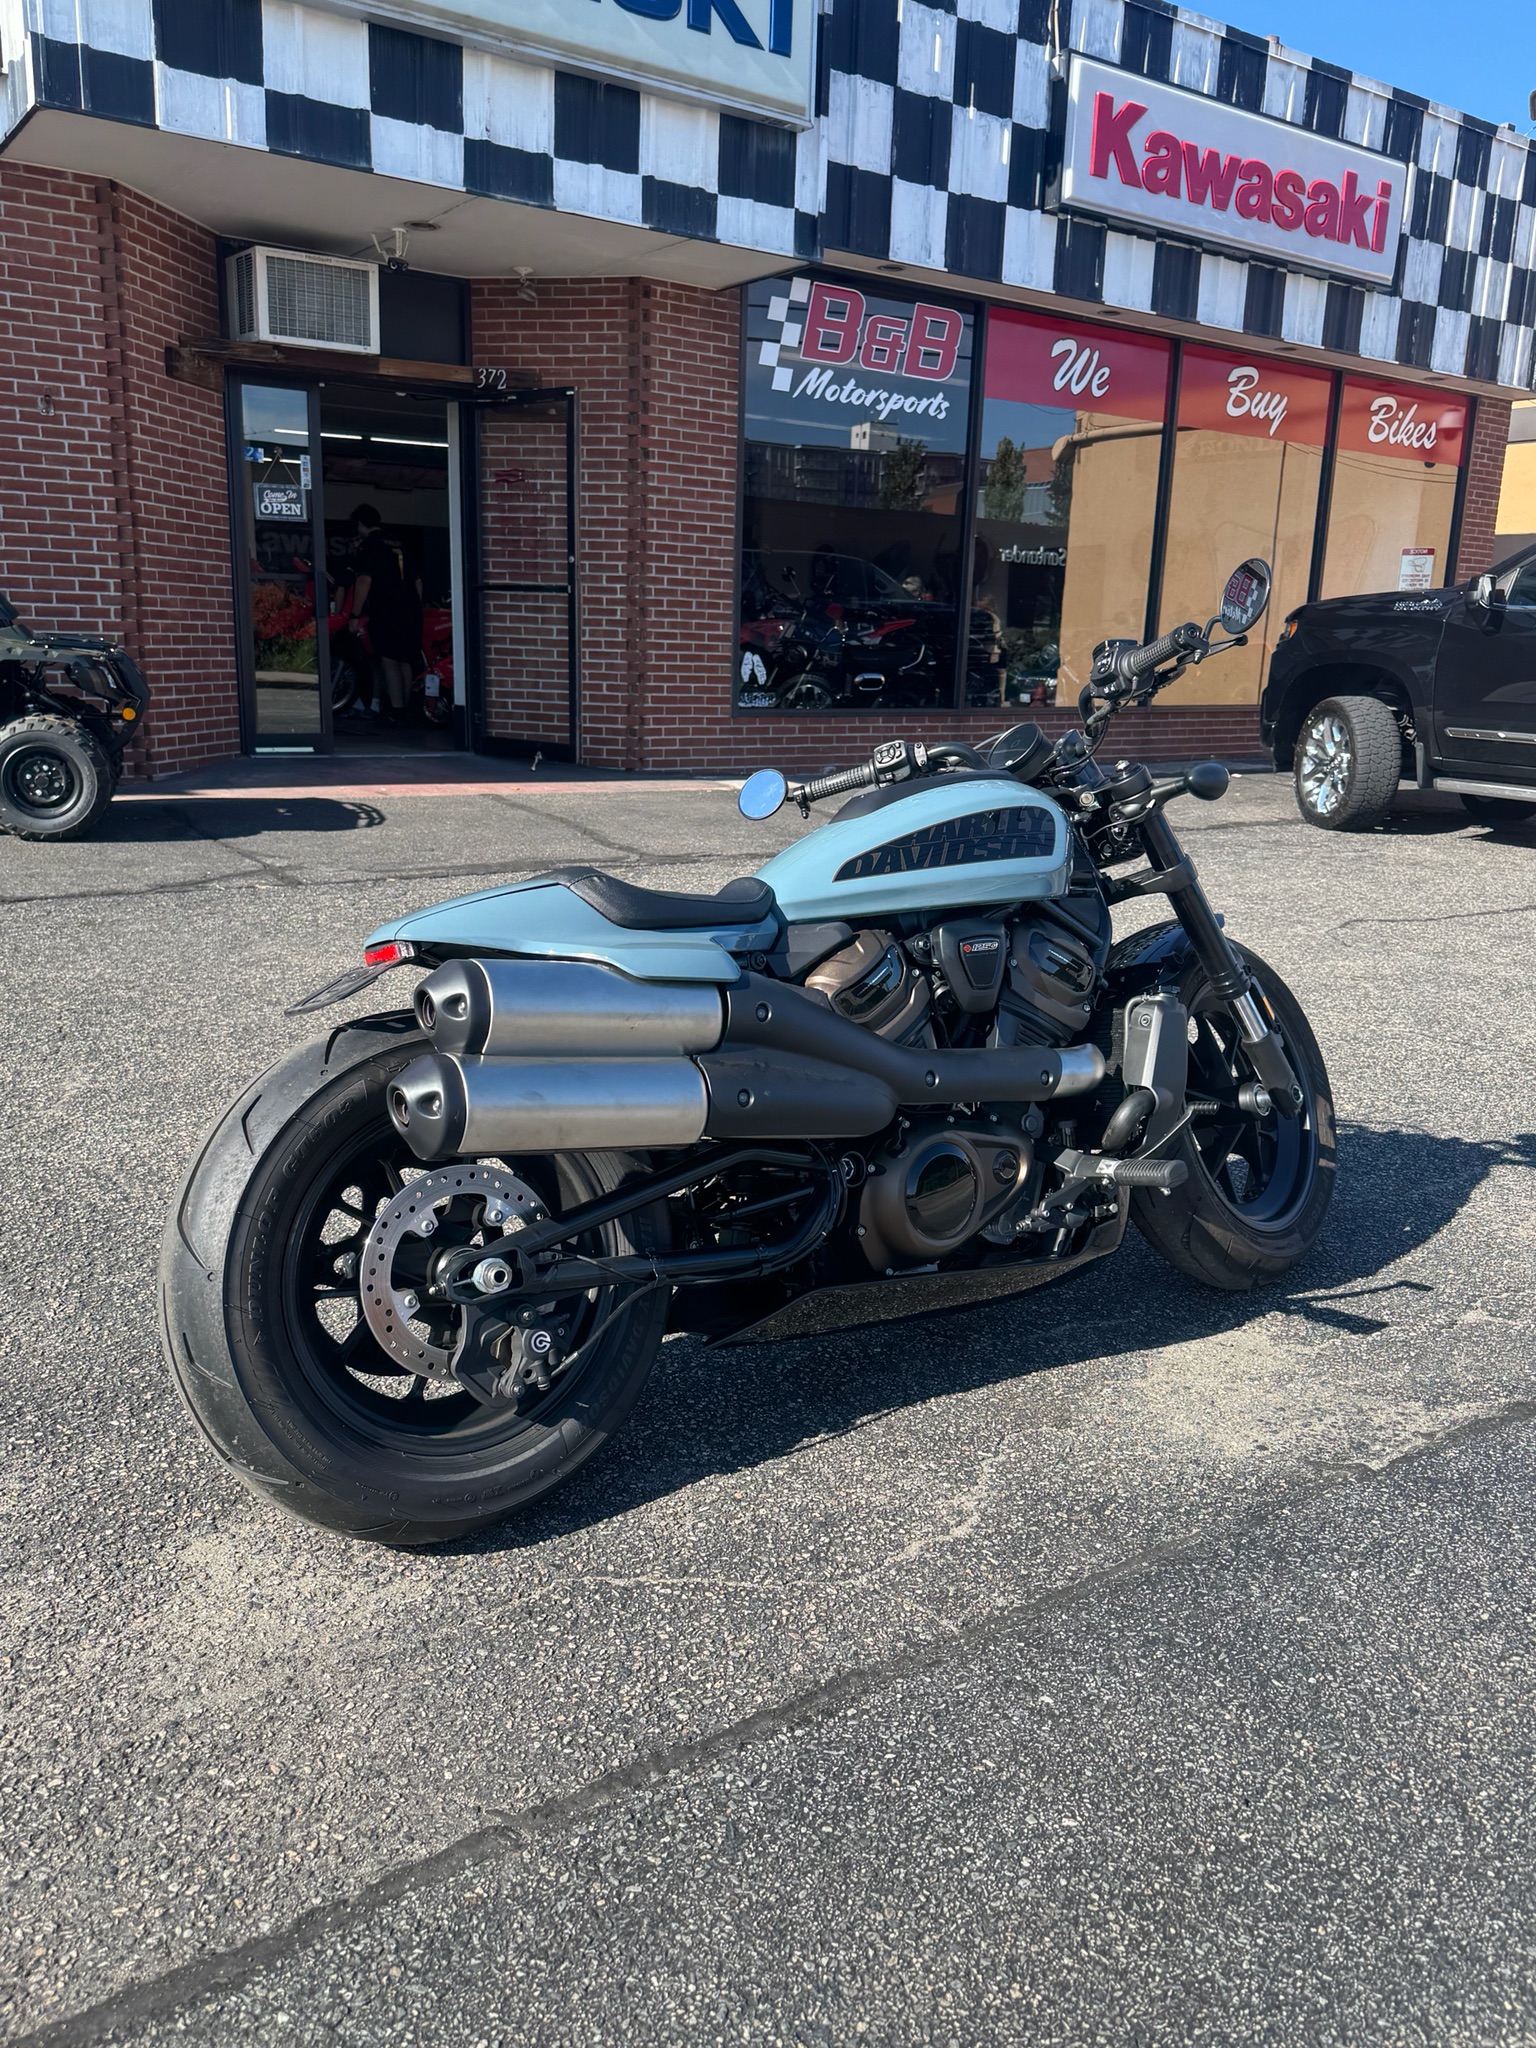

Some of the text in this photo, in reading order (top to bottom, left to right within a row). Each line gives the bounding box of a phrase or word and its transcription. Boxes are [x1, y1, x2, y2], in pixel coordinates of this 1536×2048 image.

[1090, 91, 1393, 254] Kawasaki
[800, 281, 964, 382] B&B
[477, 368, 507, 390] 372
[792, 366, 951, 421] Motorsports
[1051, 338, 1438, 450] We Buy Bikes
[260, 502, 302, 516] OPEN
[263, 489, 285, 500] Come
[285, 489, 298, 500] In
